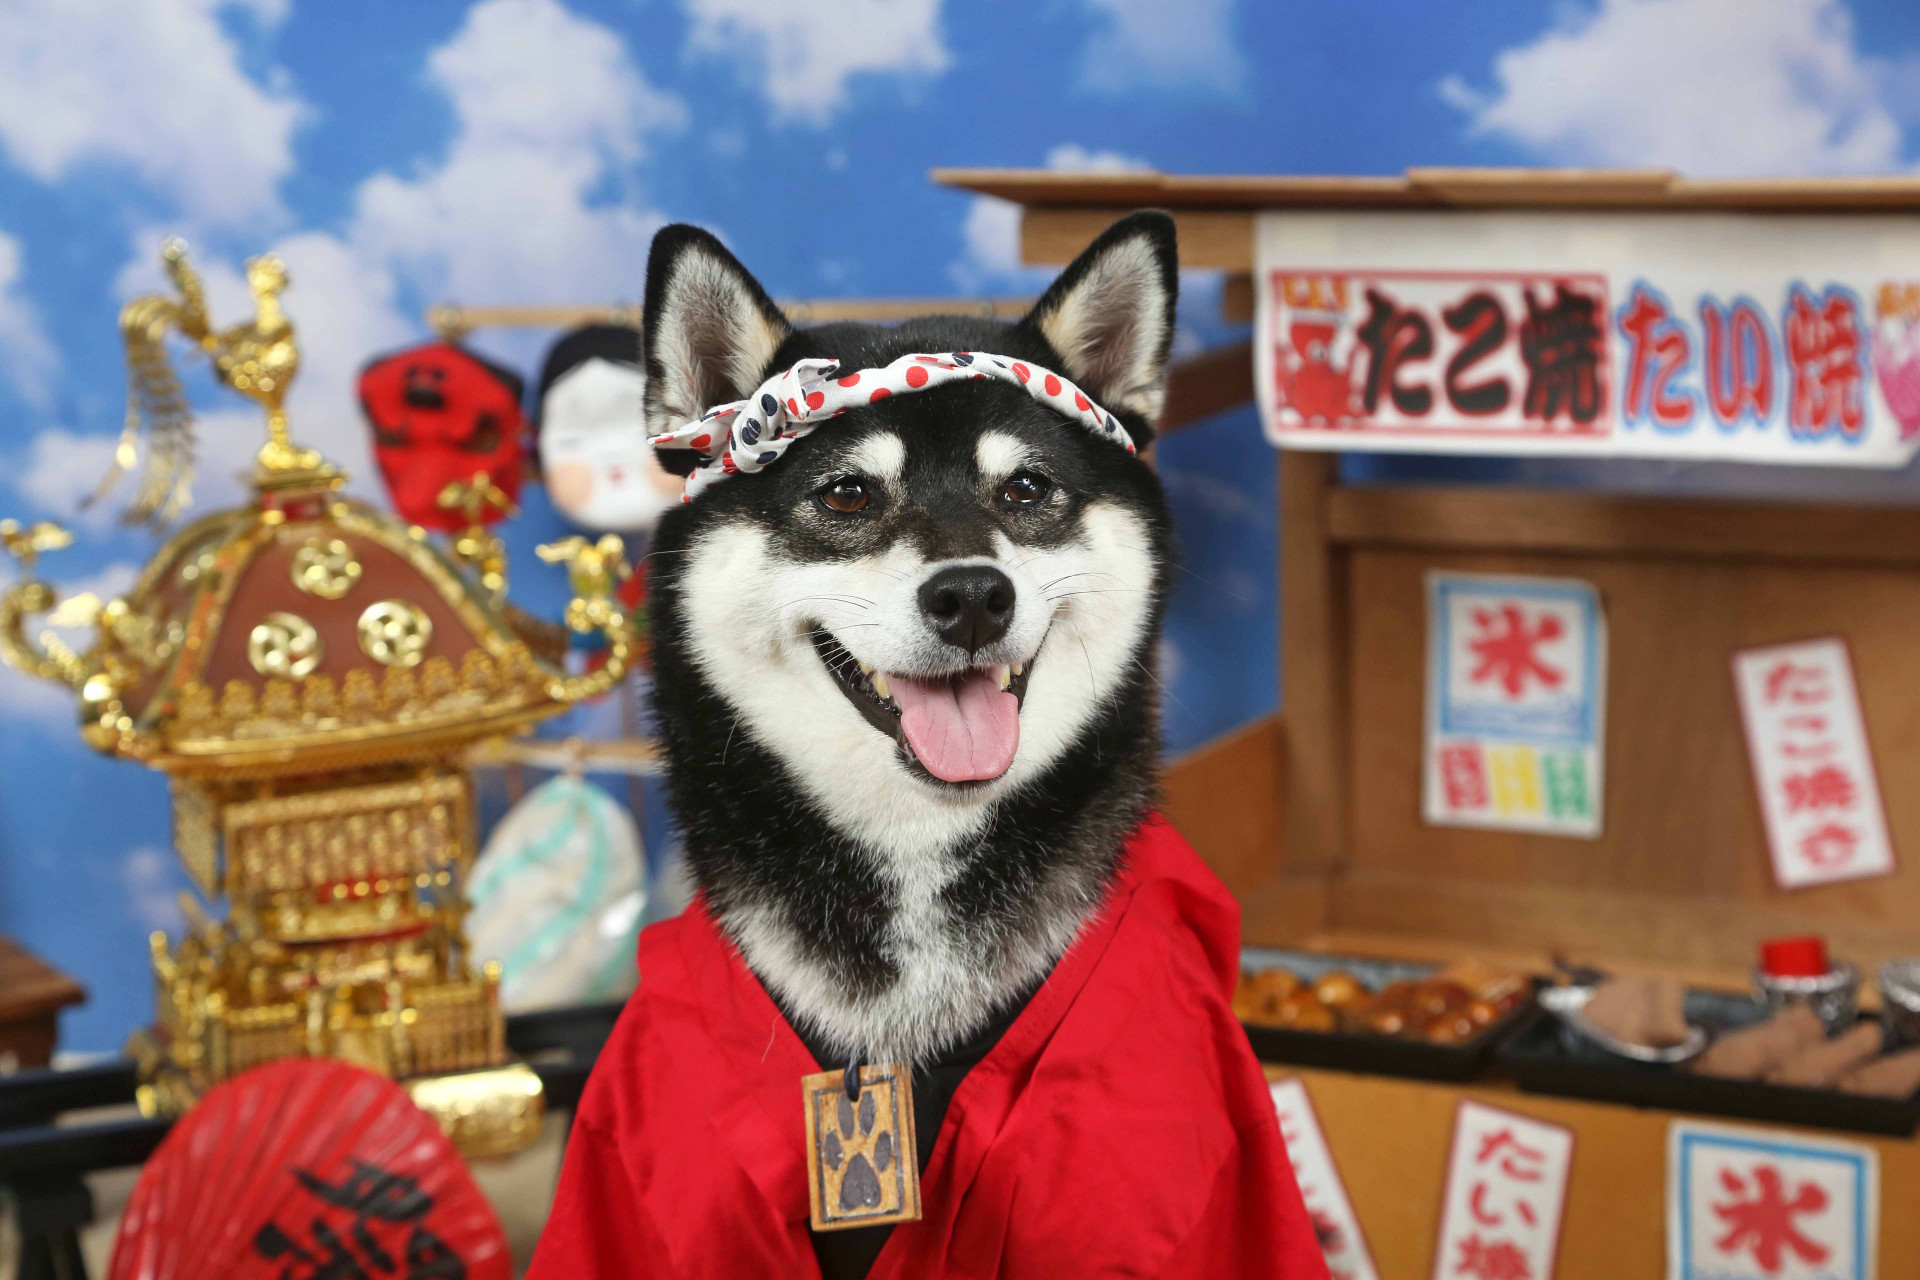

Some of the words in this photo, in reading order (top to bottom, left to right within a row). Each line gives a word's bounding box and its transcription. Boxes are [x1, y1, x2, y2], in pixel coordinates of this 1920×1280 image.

[1357, 280, 1600, 422] たこ焼
[1616, 277, 1869, 446] たい焼
[1466, 601, 1567, 701] 氷
[1711, 1163, 1833, 1277] 氷
